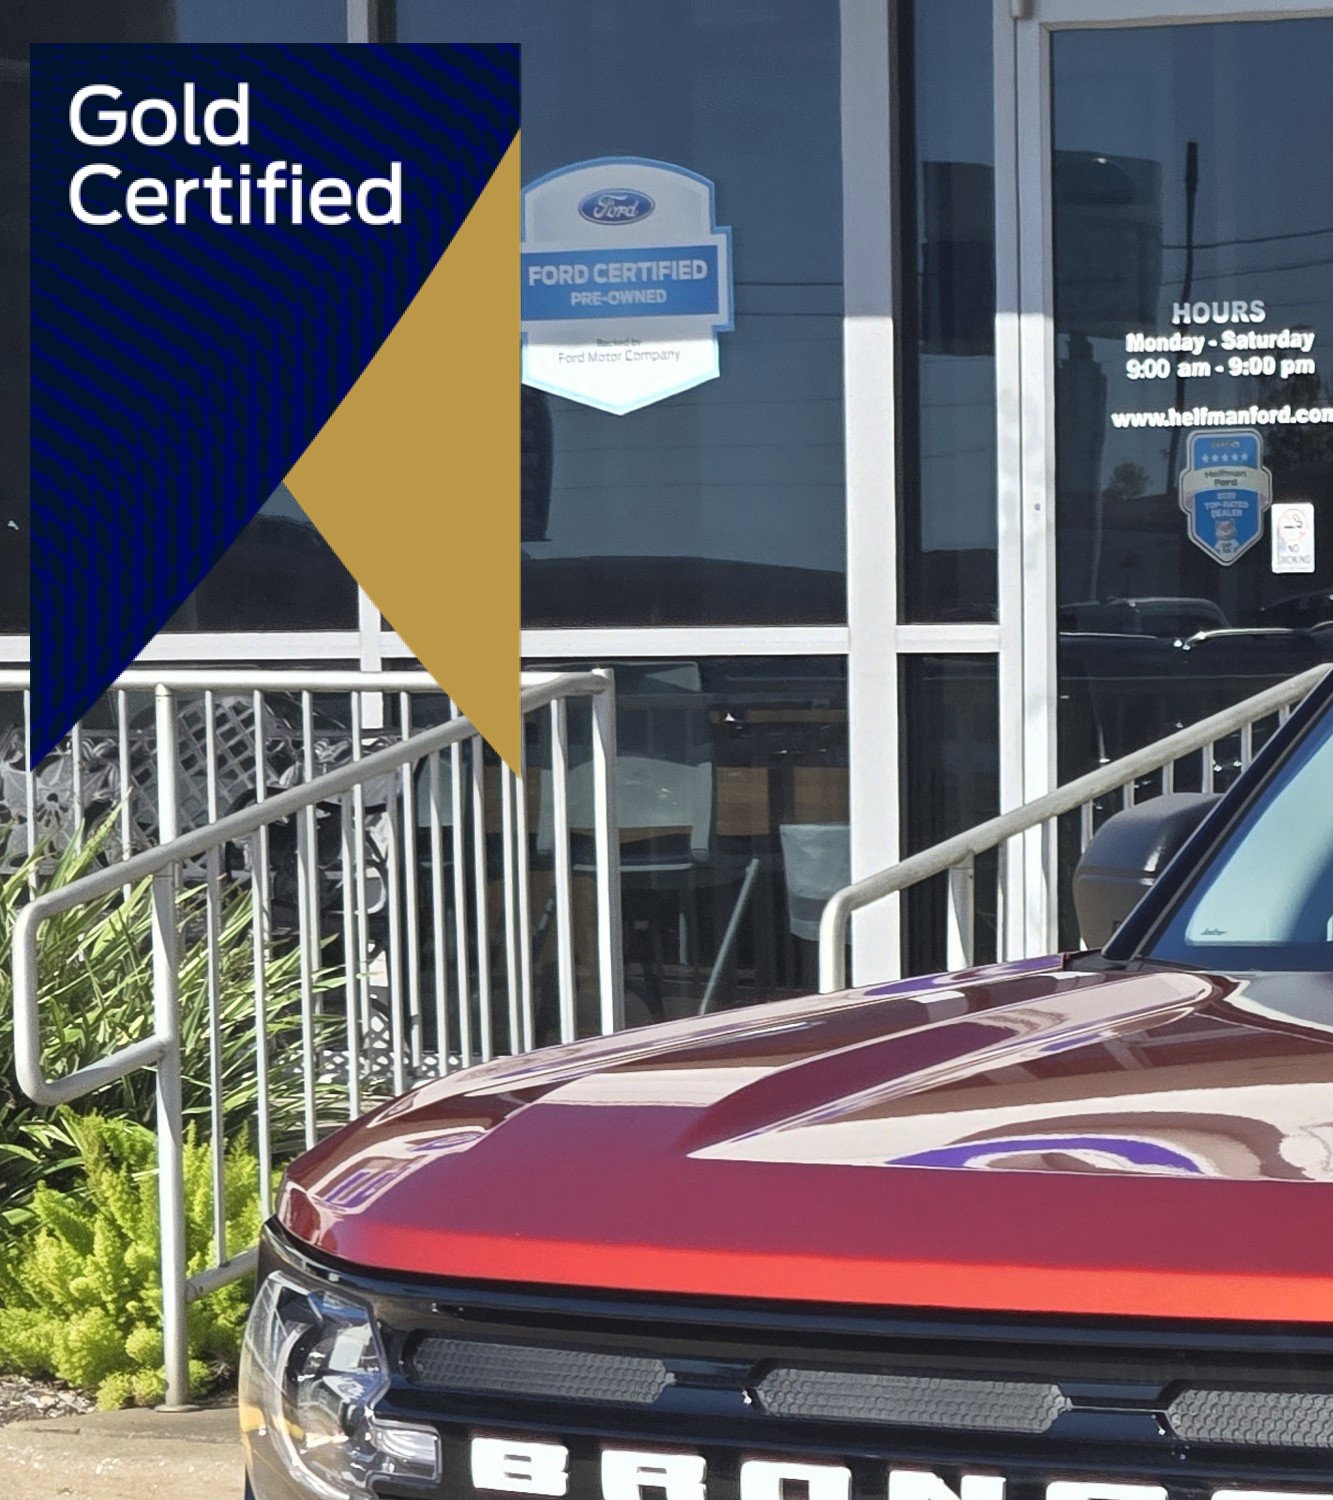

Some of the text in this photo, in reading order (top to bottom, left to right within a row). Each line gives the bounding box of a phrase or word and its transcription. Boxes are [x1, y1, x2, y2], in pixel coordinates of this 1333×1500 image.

[592, 195, 640, 218] Ford
[529, 259, 708, 286] FORD CERTIFIED
[571, 290, 667, 307] PRE-OWNED
[1172, 300, 1266, 324] HOURS
[1126, 333, 1205, 355] Monday
[1221, 329, 1315, 351] Saturday
[559, 349, 681, 363] Ford Motor Company
[1126, 358, 1170, 379] 9:00
[1177, 361, 1211, 378] am
[1228, 356, 1276, 376] 9:00
[1280, 359, 1315, 378] pm
